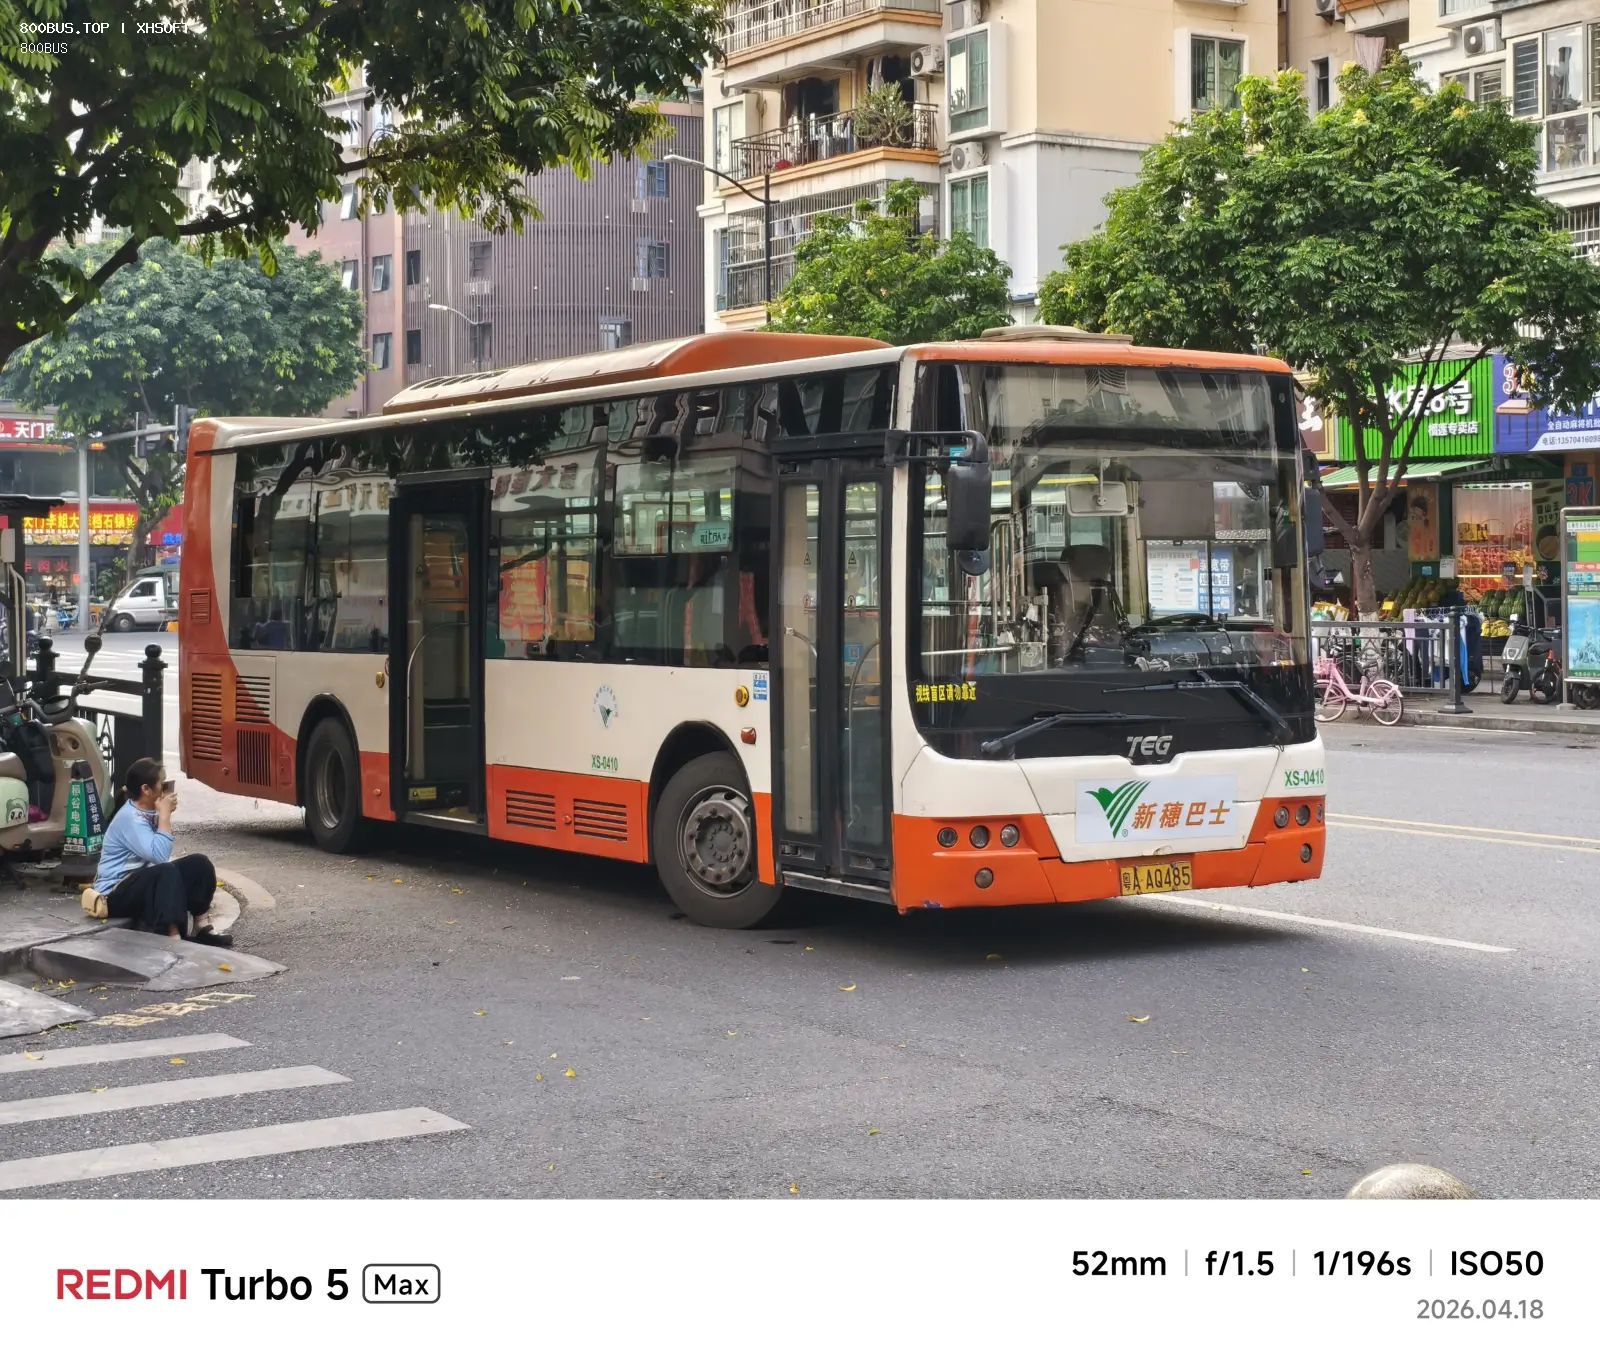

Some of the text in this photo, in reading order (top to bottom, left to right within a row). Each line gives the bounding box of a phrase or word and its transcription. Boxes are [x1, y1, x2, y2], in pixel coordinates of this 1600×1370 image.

[915, 683, 977, 702] 视线盲区请勿靠近
[591, 754, 619, 771] XS-0410
[1284, 769, 1325, 787] XS-0410
[1131, 799, 1231, 830] 新穗巴士
[1146, 865, 1191, 890] AQ485
